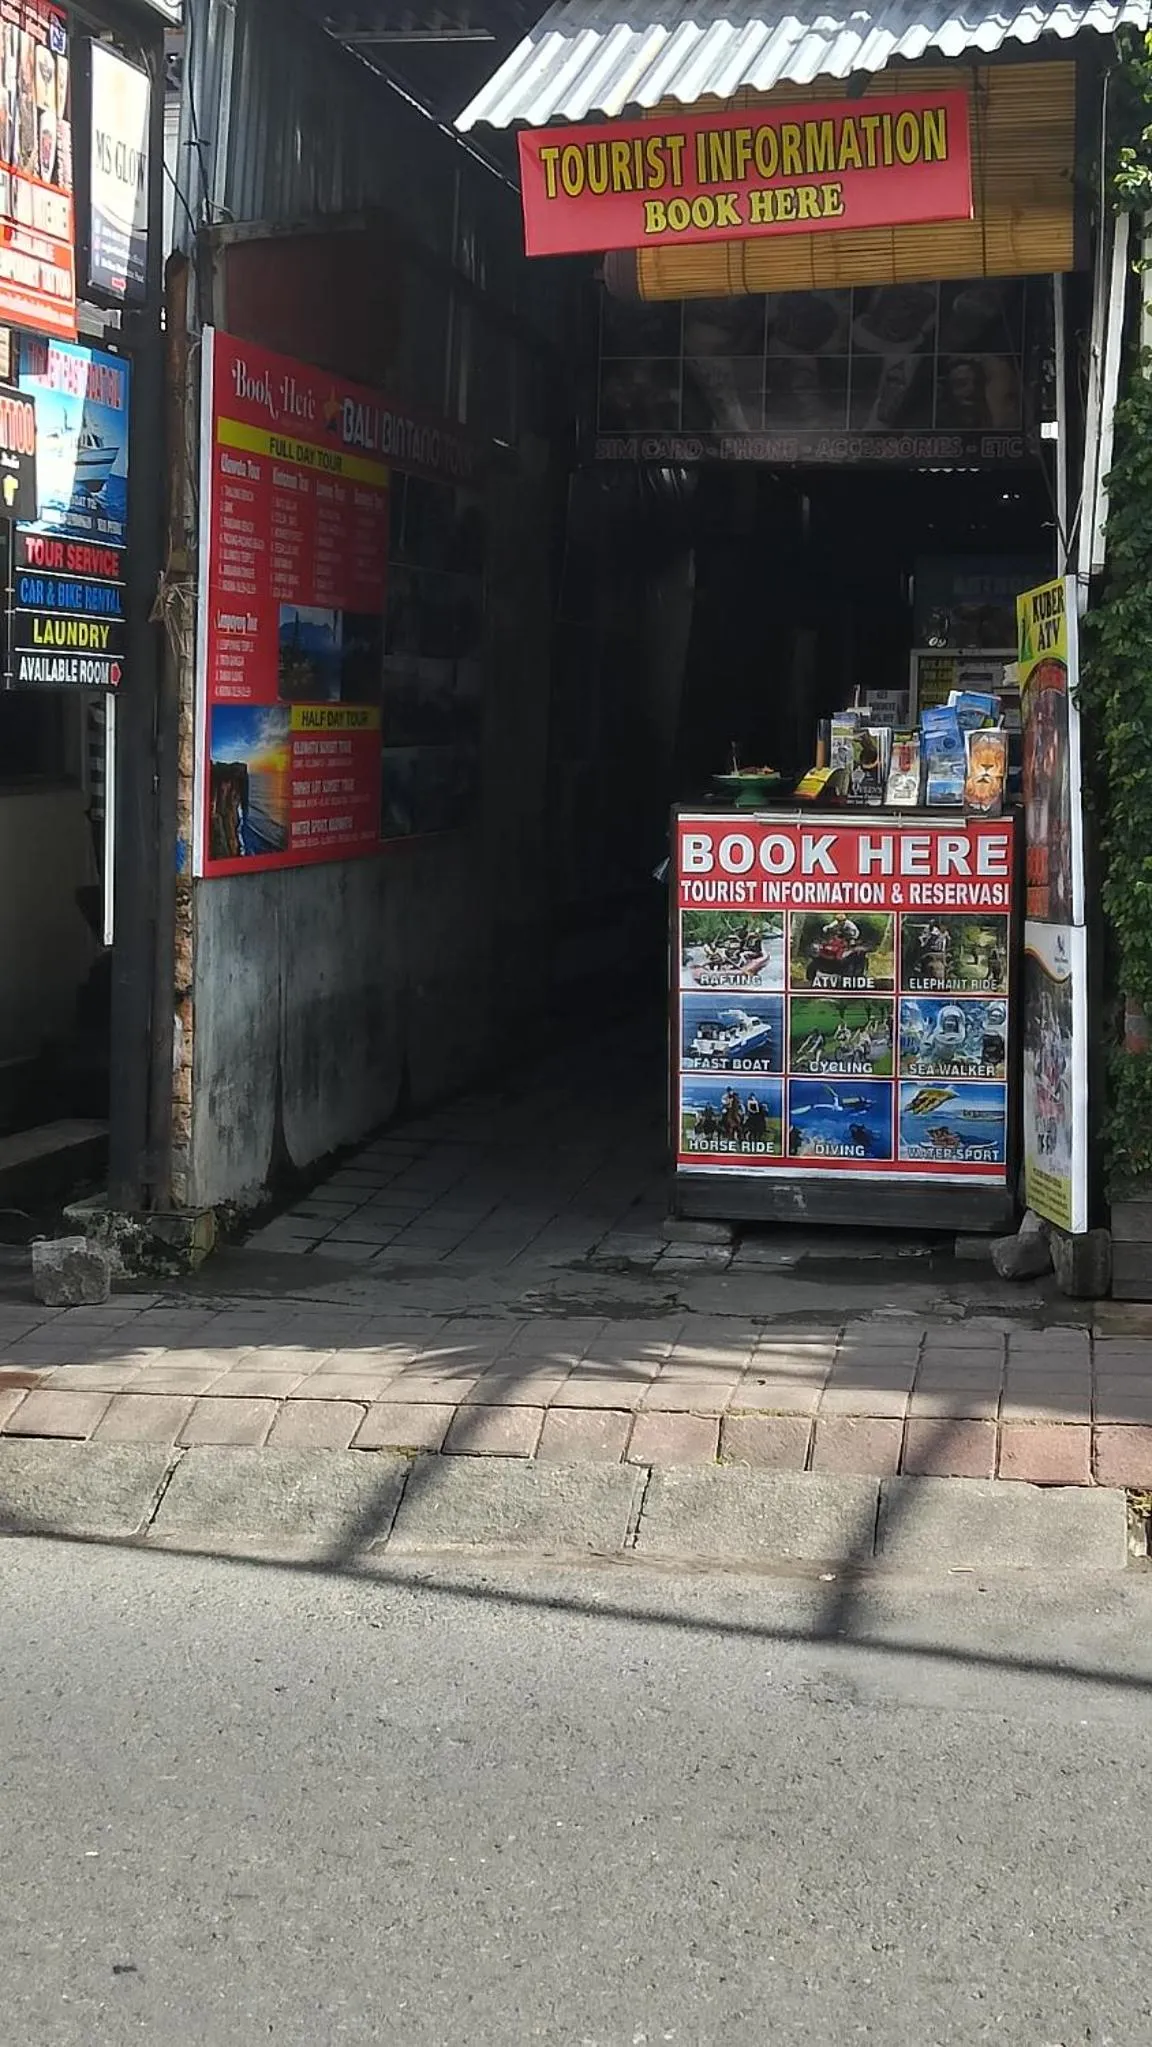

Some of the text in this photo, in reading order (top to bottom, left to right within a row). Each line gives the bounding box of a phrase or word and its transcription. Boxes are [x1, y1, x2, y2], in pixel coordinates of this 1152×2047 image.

[96, 129, 112, 174] MS
[115, 140, 147, 193] GLOW
[540, 107, 947, 199] TOURIST INFORMATION
[643, 183, 845, 233] BOOK HERE
[231, 357, 316, 420] Book Here
[342, 396, 378, 449] BALI
[270, 437, 343, 471] FULL DAY TOUR
[25, 537, 120, 577] TOUR SERVICE
[20, 577, 122, 614] CAR & BIKE RENTAL
[1032, 584, 1065, 624] KUBER
[33, 618, 110, 649] LAUNDRY
[1037, 616, 1061, 651] ATV
[19, 656, 110, 684] AVAILABLE ROOM
[301, 709, 369, 726] HALF DAY TOUR
[680, 833, 1009, 877] BOOK HERE
[680, 880, 1010, 906] TOURIST INFORMATION & RESERVASI
[699, 973, 763, 987] RAFTING
[811, 976, 876, 989] ATV RIDE
[909, 977, 998, 991] ELEPHANT RIDE
[693, 1057, 771, 1071] FAST BOAT
[808, 1060, 873, 1073] CYCLING
[909, 1063, 996, 1077] SEA WALKER
[688, 1139, 775, 1153] HORSE RIDE
[814, 1143, 866, 1157] DIVING
[909, 1147, 1000, 1160] WATER SPORT
